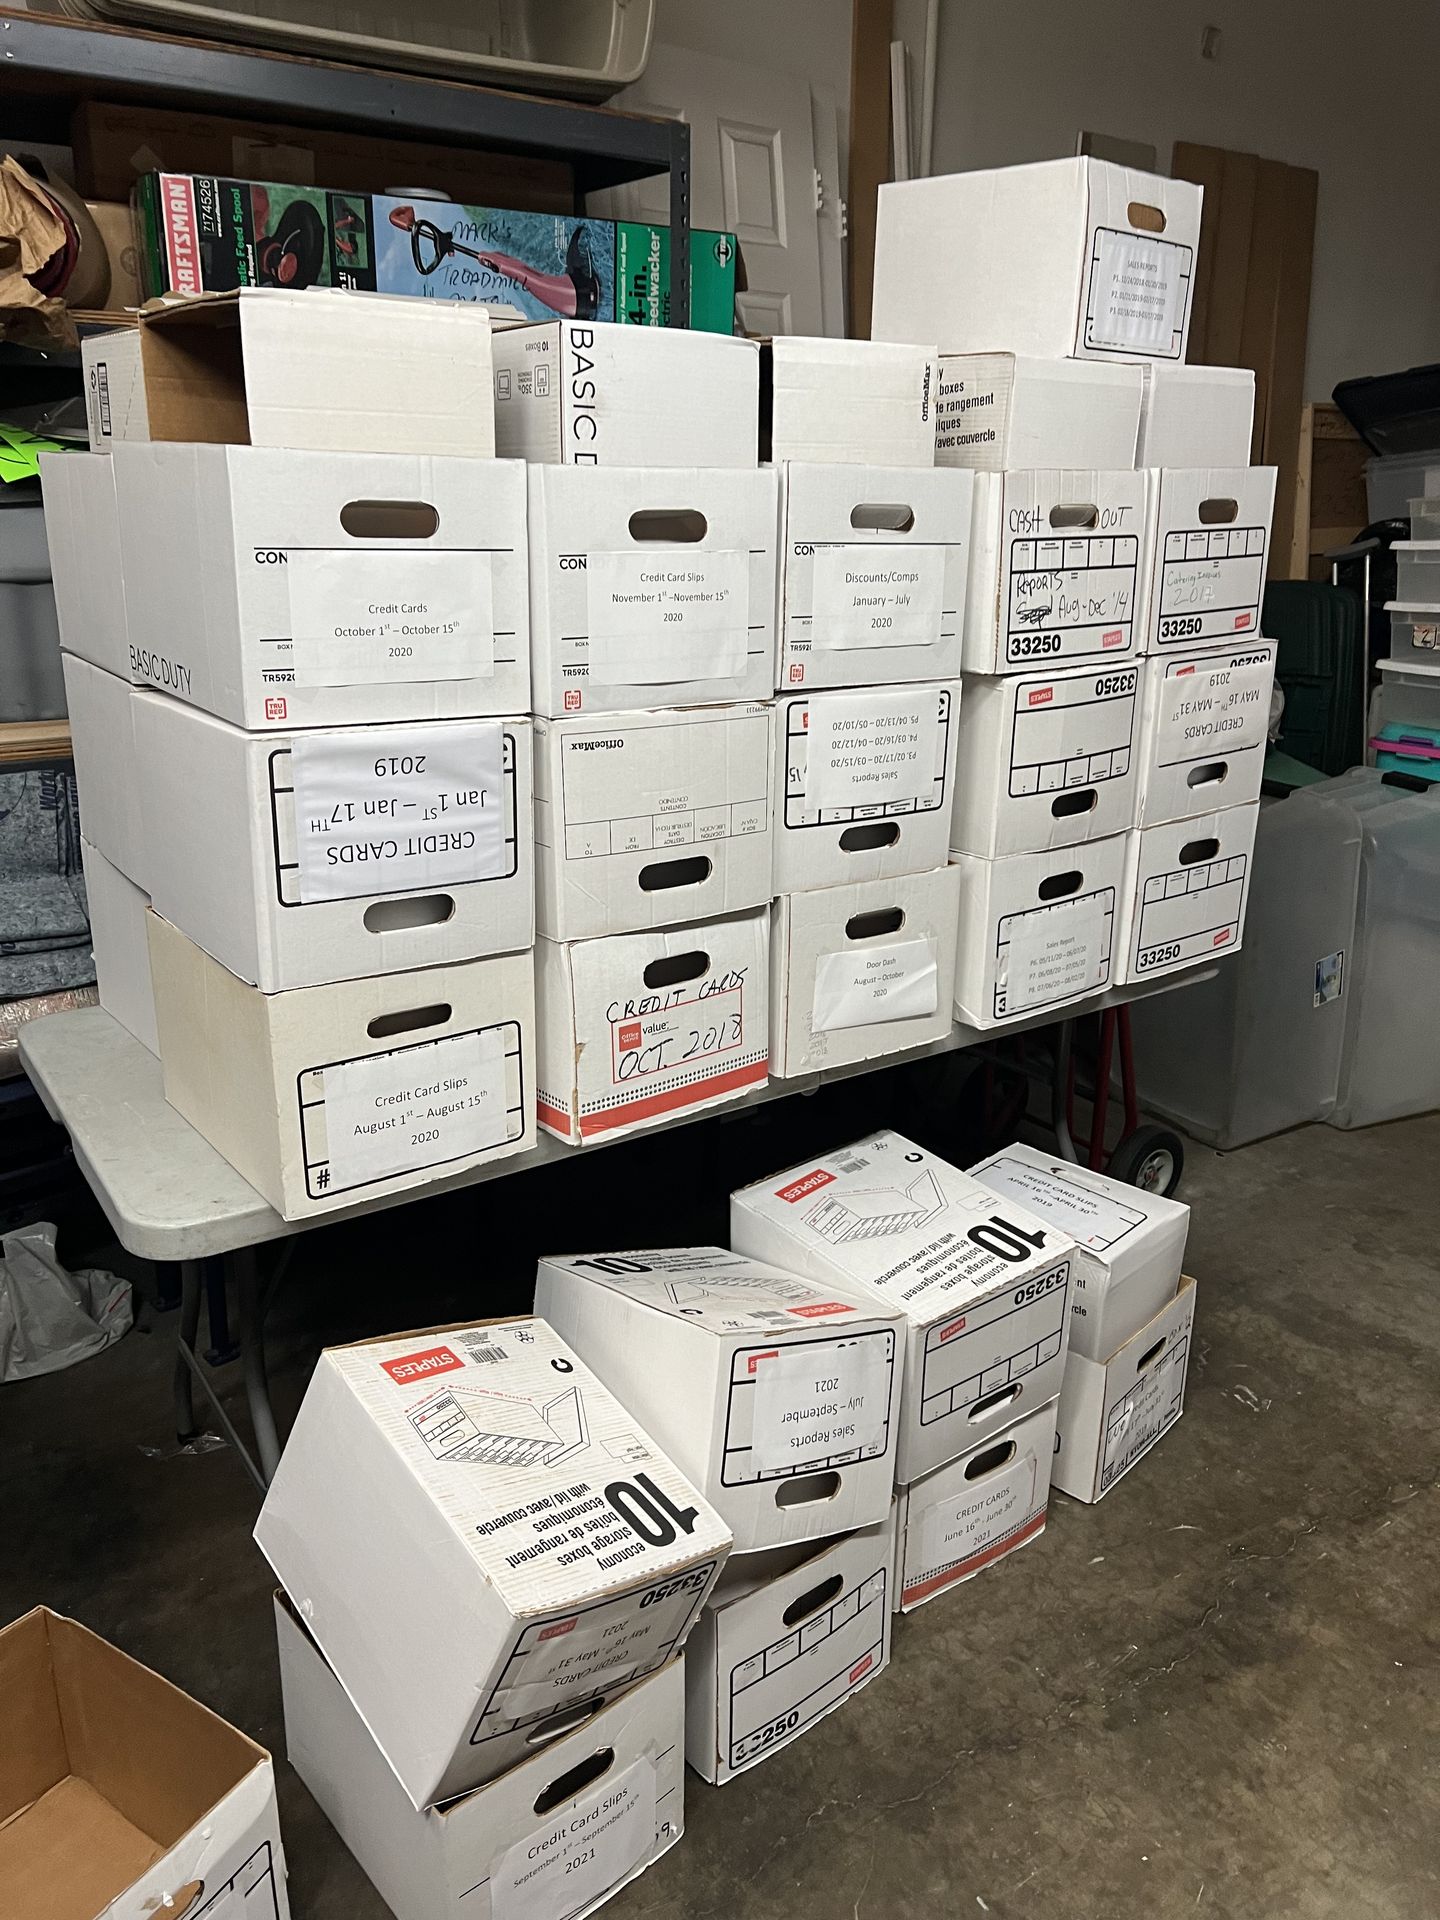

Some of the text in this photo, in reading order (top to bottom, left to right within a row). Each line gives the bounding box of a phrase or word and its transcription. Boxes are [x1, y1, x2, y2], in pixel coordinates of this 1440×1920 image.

[200, 179, 213, 233] 7174526
[231, 188, 245, 257] Feed Spool
[169, 182, 197, 295] RAFTSMAN
[525, 342, 541, 351] Boxes
[570, 328, 597, 440] BASIC
[922, 362, 931, 421] OfficeMax
[940, 381, 964, 395] boxes
[947, 392, 994, 412] rangement
[957, 429, 995, 445] couvercle
[1009, 505, 1133, 533] CASH OUT
[640, 573, 705, 583] Credit Card Slips
[845, 571, 919, 584] Discounts/Comps
[368, 603, 428, 614] Credit Cards
[612, 590, 729, 603] November 1st 15th
[853, 594, 911, 607] January July
[334, 620, 460, 637] October 1st October 15th
[663, 613, 683, 622] 2020
[871, 617, 893, 628] 2020
[1161, 618, 1202, 638] 33250
[388, 647, 413, 657] 2020
[1011, 635, 1061, 655] 33250
[130, 644, 190, 695] BASIC DUTY
[1210, 672, 1230, 686] 2019
[1096, 674, 1134, 696] 33250
[1240, 689, 1260, 704] MAY
[1192, 699, 1212, 713] MAY
[832, 720, 868, 730] 05/10/20
[876, 716, 908, 728] 04/13/20
[1185, 716, 1244, 739] CREDIT CARDS
[571, 739, 624, 751] OfficeMax
[832, 739, 867, 749] 04/12/20
[875, 734, 906, 746] 03/16/20
[375, 756, 426, 777] 2019
[831, 757, 866, 767] 03/15/20
[874, 753, 905, 763] 02/17/20
[852, 771, 898, 783] Sales Reports
[311, 791, 487, 832] Jan 1ST Jan 17TH
[326, 831, 475, 865] CREDIT CARDS
[866, 958, 896, 969] Door Dash
[1140, 944, 1180, 968] 33250
[853, 971, 904, 985] August October
[606, 967, 748, 1023] CREDIT CARDS
[873, 989, 888, 998] 2020
[619, 1014, 742, 1080] OCT. 2018
[375, 1077, 468, 1108] Credit Card Slips
[354, 1090, 488, 1136] August 1st August 15th
[411, 1129, 440, 1146] 2020
[784, 1173, 829, 1200] STAPLES
[1007, 1177, 1030, 1188] APRIL
[1023, 1174, 1098, 1209] CREDIT CARD SLIPS
[1032, 1196, 1053, 1208] 2019
[967, 1216, 1047, 1262] 10
[570, 1257, 653, 1275] 10
[874, 1233, 957, 1285] with lid couvercle
[916, 1239, 970, 1274] économiques
[901, 1262, 958, 1301] de rangement
[940, 1254, 996, 1292] storage boxes
[971, 1262, 1009, 1287] economy
[1014, 1268, 1065, 1306] 33250
[392, 1353, 455, 1378] STAPLES
[815, 1378, 839, 1393] 2021
[782, 1396, 864, 1423] July September
[790, 1424, 855, 1448] Sales Reports
[476, 1483, 591, 1535] with lid couvercle
[533, 1496, 605, 1533] économiques
[604, 1472, 700, 1547] 10
[956, 1486, 1010, 1520] CREDIT CARDS
[944, 1509, 1003, 1543] June June
[973, 1529, 991, 1546] 2021
[505, 1511, 621, 1569] boîtes de rangement
[557, 1526, 633, 1567] storage boxes
[599, 1541, 646, 1571] economy
[640, 1569, 710, 1609] 33250
[602, 1620, 629, 1639] 2021
[575, 1625, 651, 1664] May May
[553, 1650, 629, 1688] CREDIT CARDS
[528, 1787, 628, 1860] Credit Card Slips
[513, 1810, 623, 1888] September September
[565, 1847, 596, 1874] 2021
